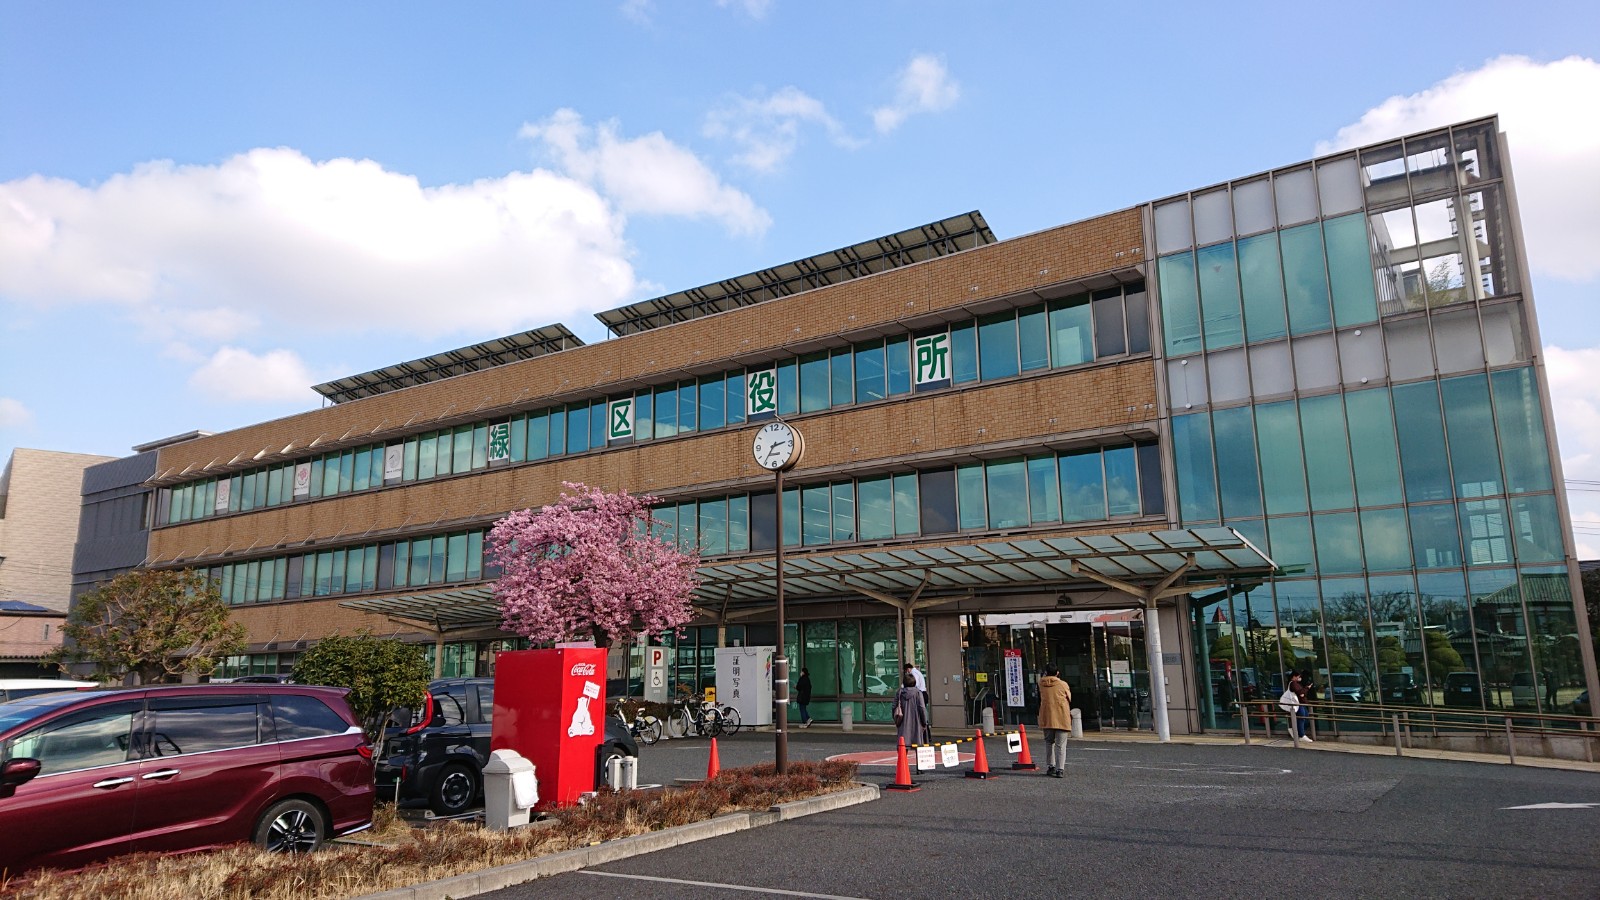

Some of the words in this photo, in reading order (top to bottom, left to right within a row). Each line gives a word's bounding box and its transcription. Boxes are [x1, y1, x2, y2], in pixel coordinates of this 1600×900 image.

[654, 650, 662, 665] P
[732, 656, 740, 698] 証明写真
